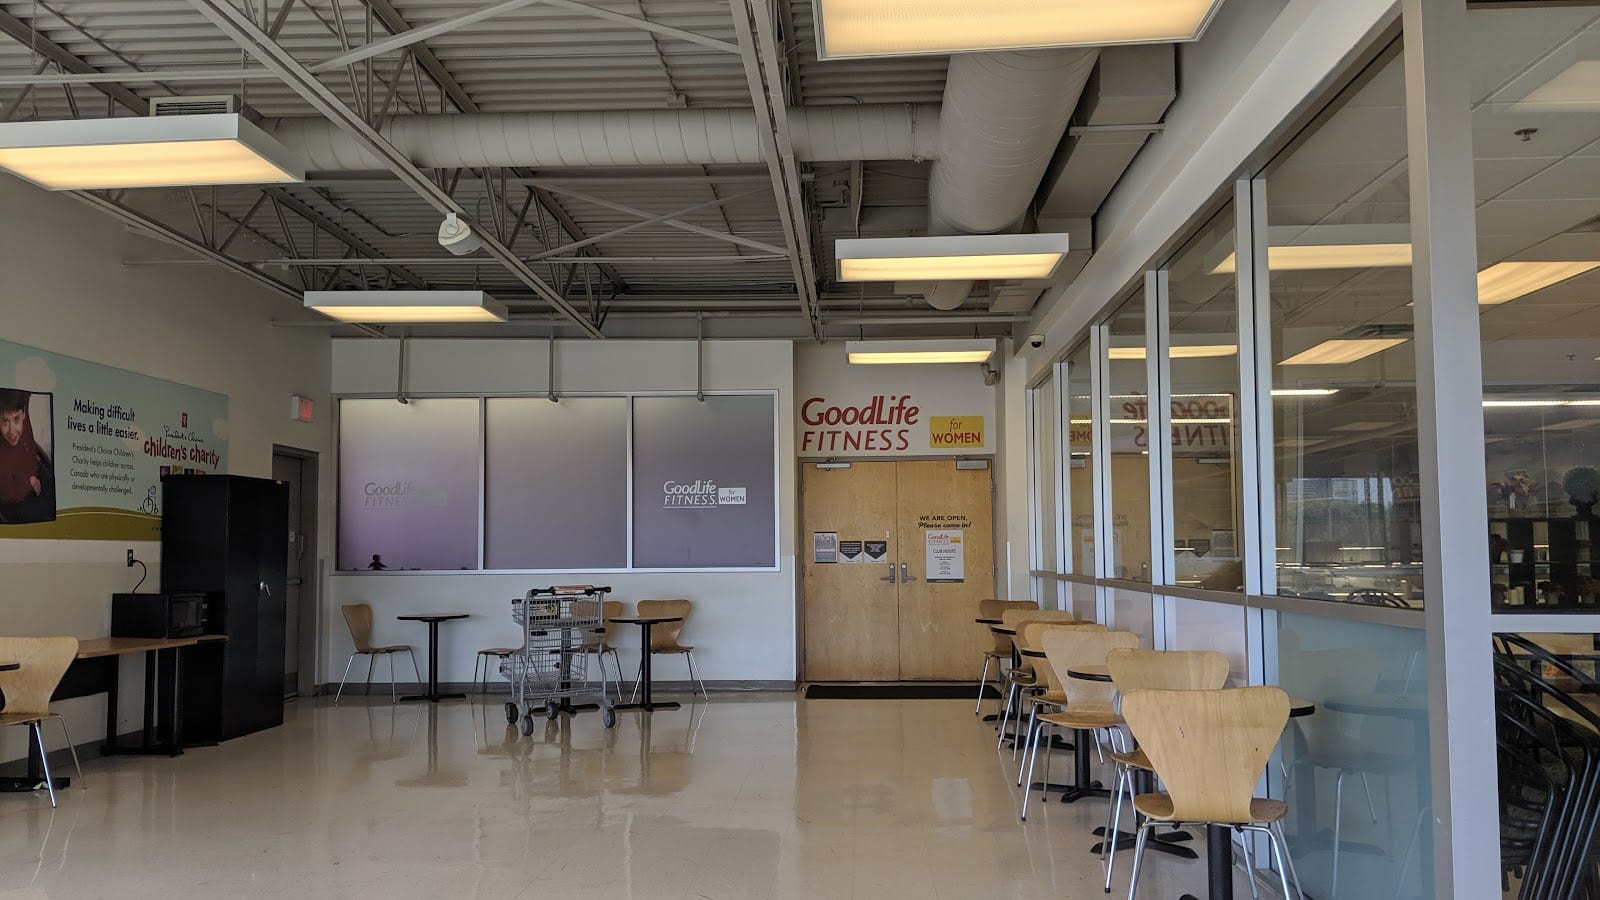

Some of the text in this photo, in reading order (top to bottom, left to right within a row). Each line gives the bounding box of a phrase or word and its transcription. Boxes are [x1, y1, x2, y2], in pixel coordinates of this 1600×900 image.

[73, 398, 135, 422] Making difficult
[801, 395, 920, 426] GoodLife
[67, 415, 139, 440] lives a little easier.
[949, 418, 962, 433] for
[802, 429, 909, 451] FITNESS
[931, 431, 981, 444] WOMEN
[143, 436, 220, 470] children's charity
[663, 480, 717, 494] GoodLife
